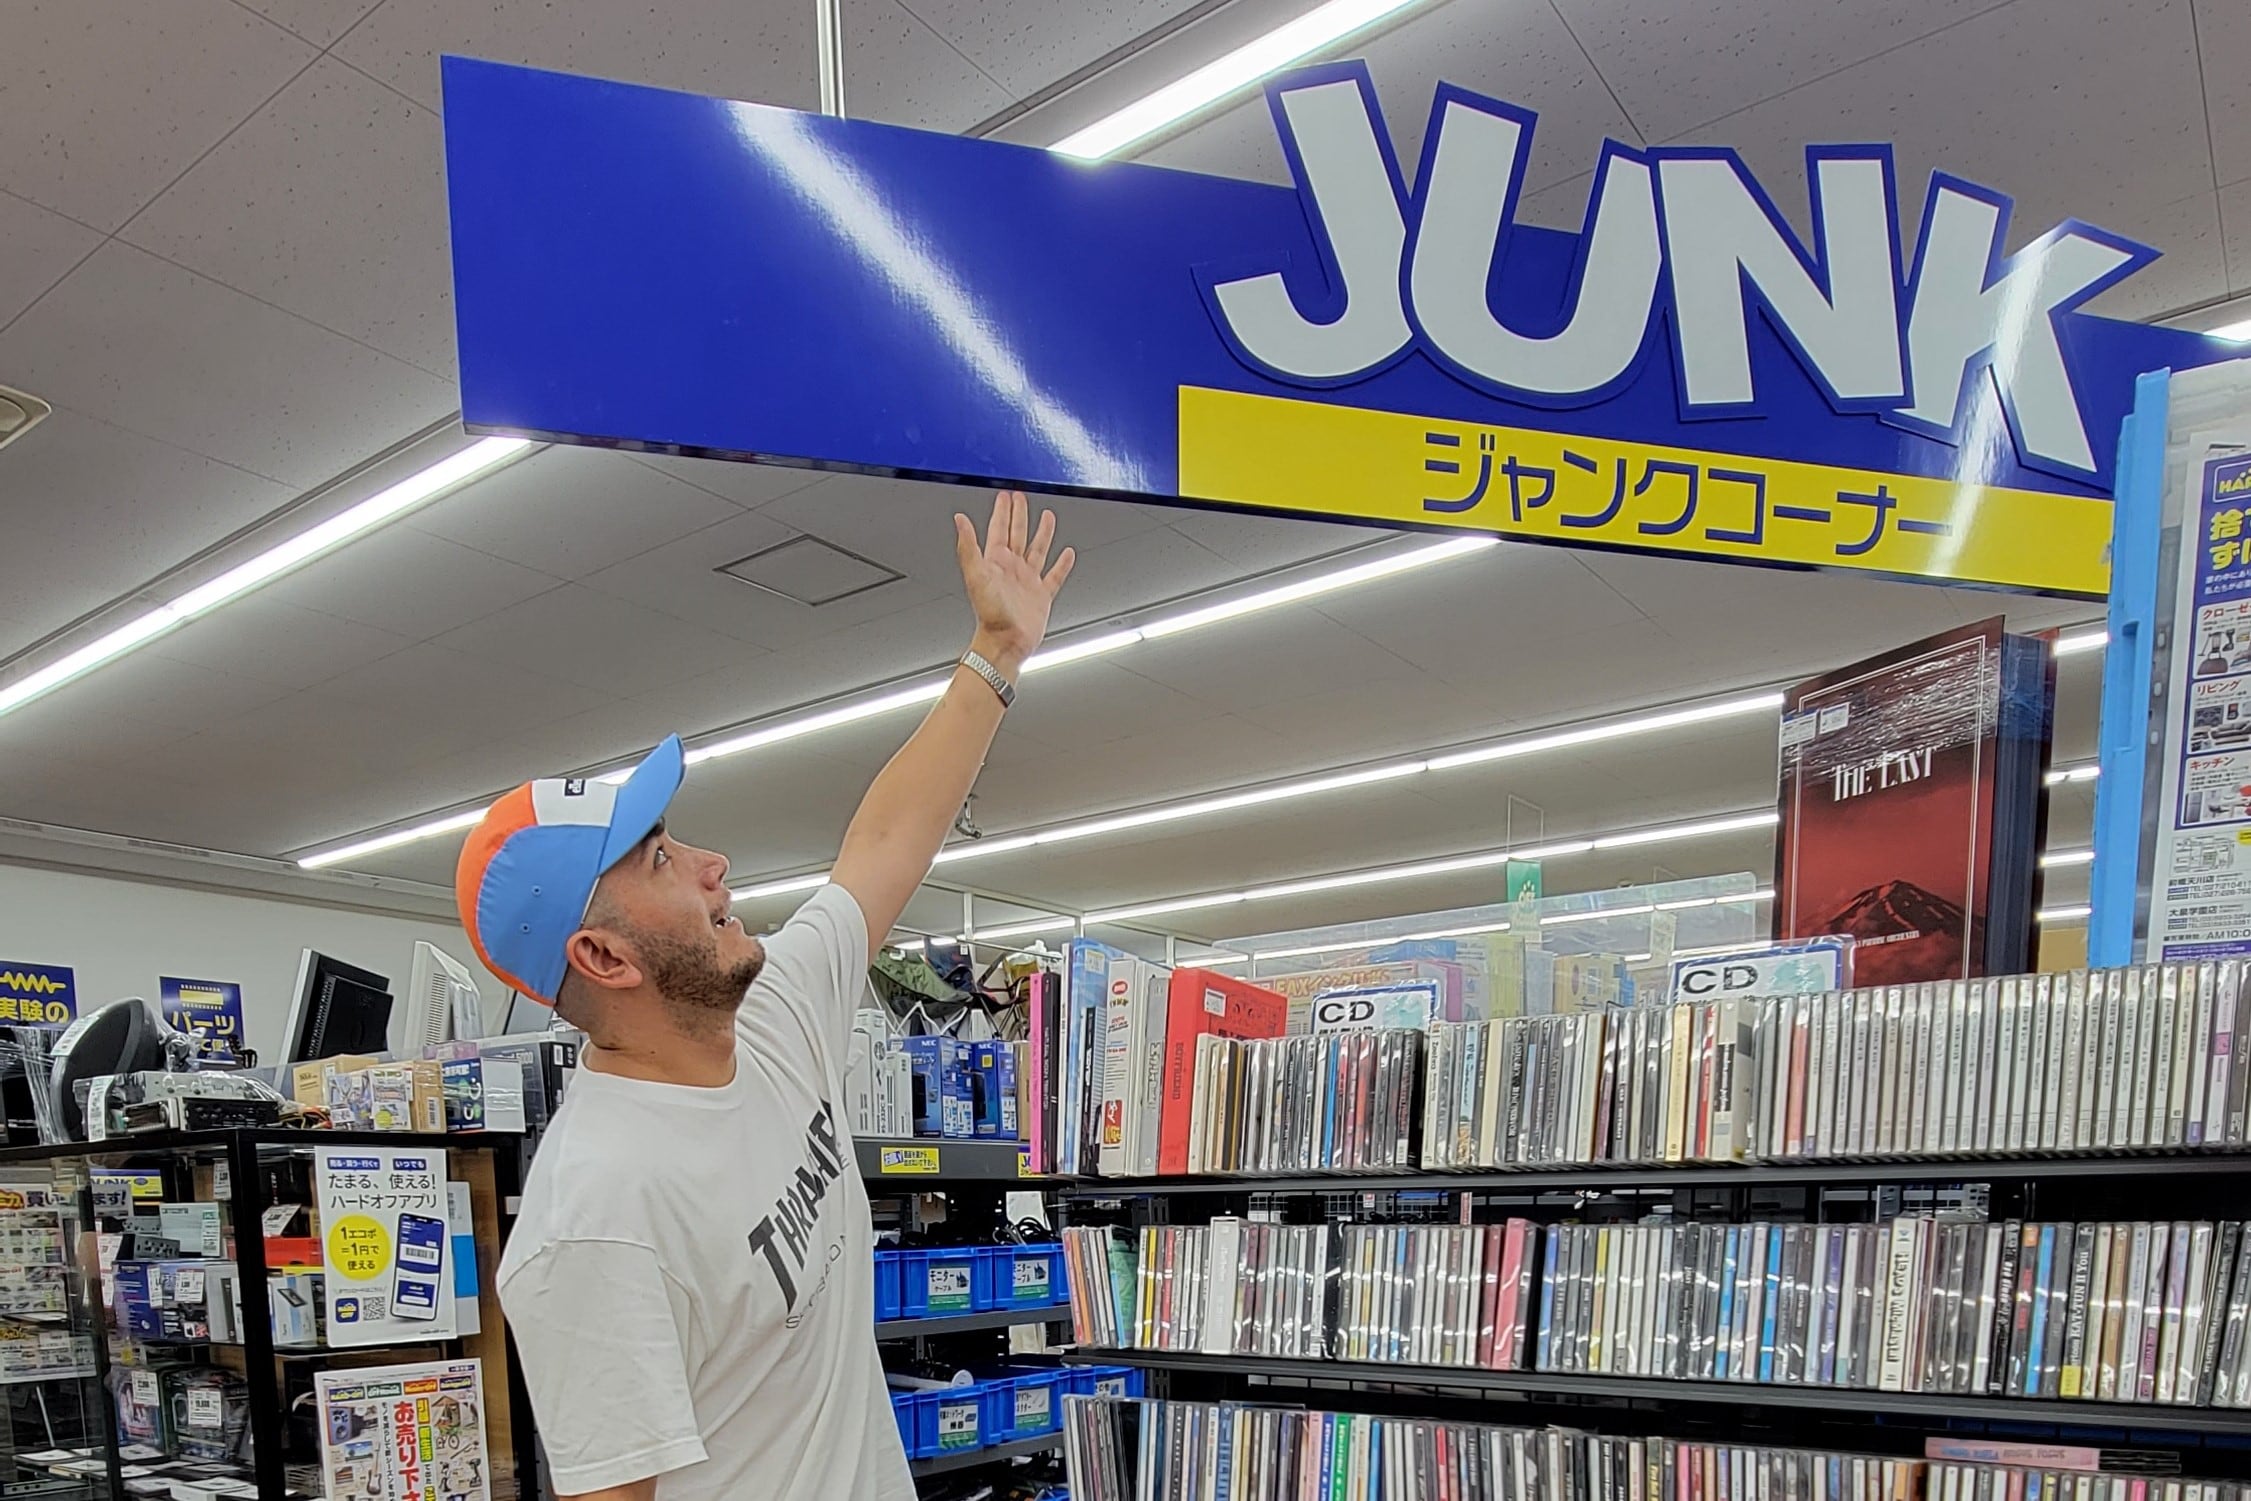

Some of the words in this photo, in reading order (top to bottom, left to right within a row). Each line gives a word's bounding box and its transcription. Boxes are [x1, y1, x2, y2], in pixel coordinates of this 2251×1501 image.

[1212, 78, 2134, 474] JUNK
[1422, 430, 1953, 556] ジャンクコーナー
[2197, 680, 2241, 695] リビング
[2190, 757, 2235, 770] キッチン
[1834, 764, 1873, 802] THE
[1682, 965, 1758, 995] CD
[1318, 1000, 1375, 1023] CD
[172, 1010, 235, 1036] パーツ
[395, 1160, 425, 1169] いつでも
[331, 1194, 437, 1210] ハードオフアプリ
[340, 1226, 377, 1241] 1エコポ
[347, 1259, 376, 1271] 使える
[2078, 1251, 2089, 1271] You
[930, 1269, 955, 1282] モニター
